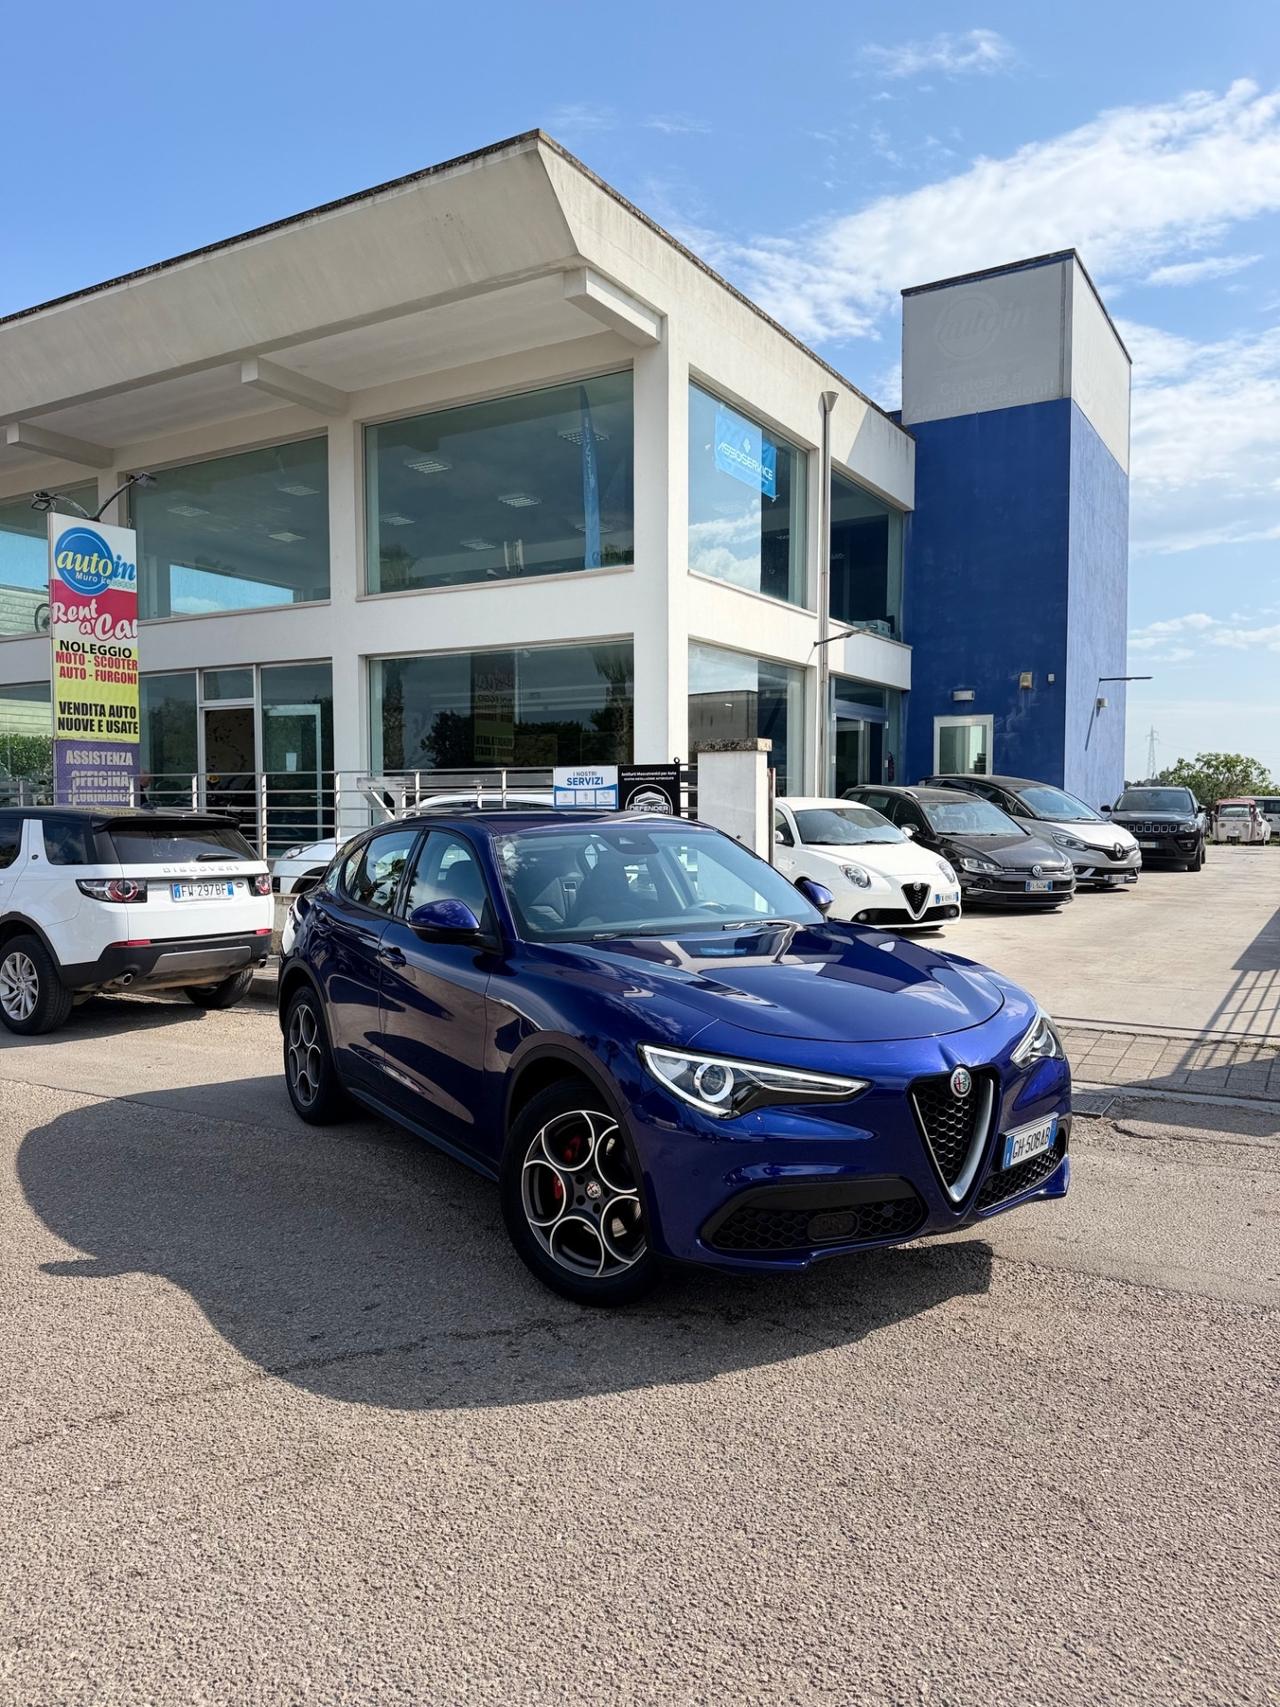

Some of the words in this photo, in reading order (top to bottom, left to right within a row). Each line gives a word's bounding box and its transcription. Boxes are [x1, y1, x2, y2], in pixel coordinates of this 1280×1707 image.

[75, 572, 98, 583] Muro
[51, 598, 98, 624] Rent
[59, 640, 132, 658] NOLEGGIO
[56, 651, 86, 666] MOTO
[94, 655, 138, 671] SCOOTER
[59, 667, 87, 681] AUTO
[95, 669, 137, 685] FURGONI
[59, 701, 106, 718] VENDITA
[109, 705, 137, 719] AUTO
[58, 717, 95, 732] NUOVE
[98, 719, 104, 733] E
[106, 720, 139, 734] USATE
[66, 750, 134, 766] ASSISTENZA
[71, 770, 130, 787] OFFICINA
[566, 776, 604, 786] SERVIZI
[162, 865, 240, 874] DISCOVERY
